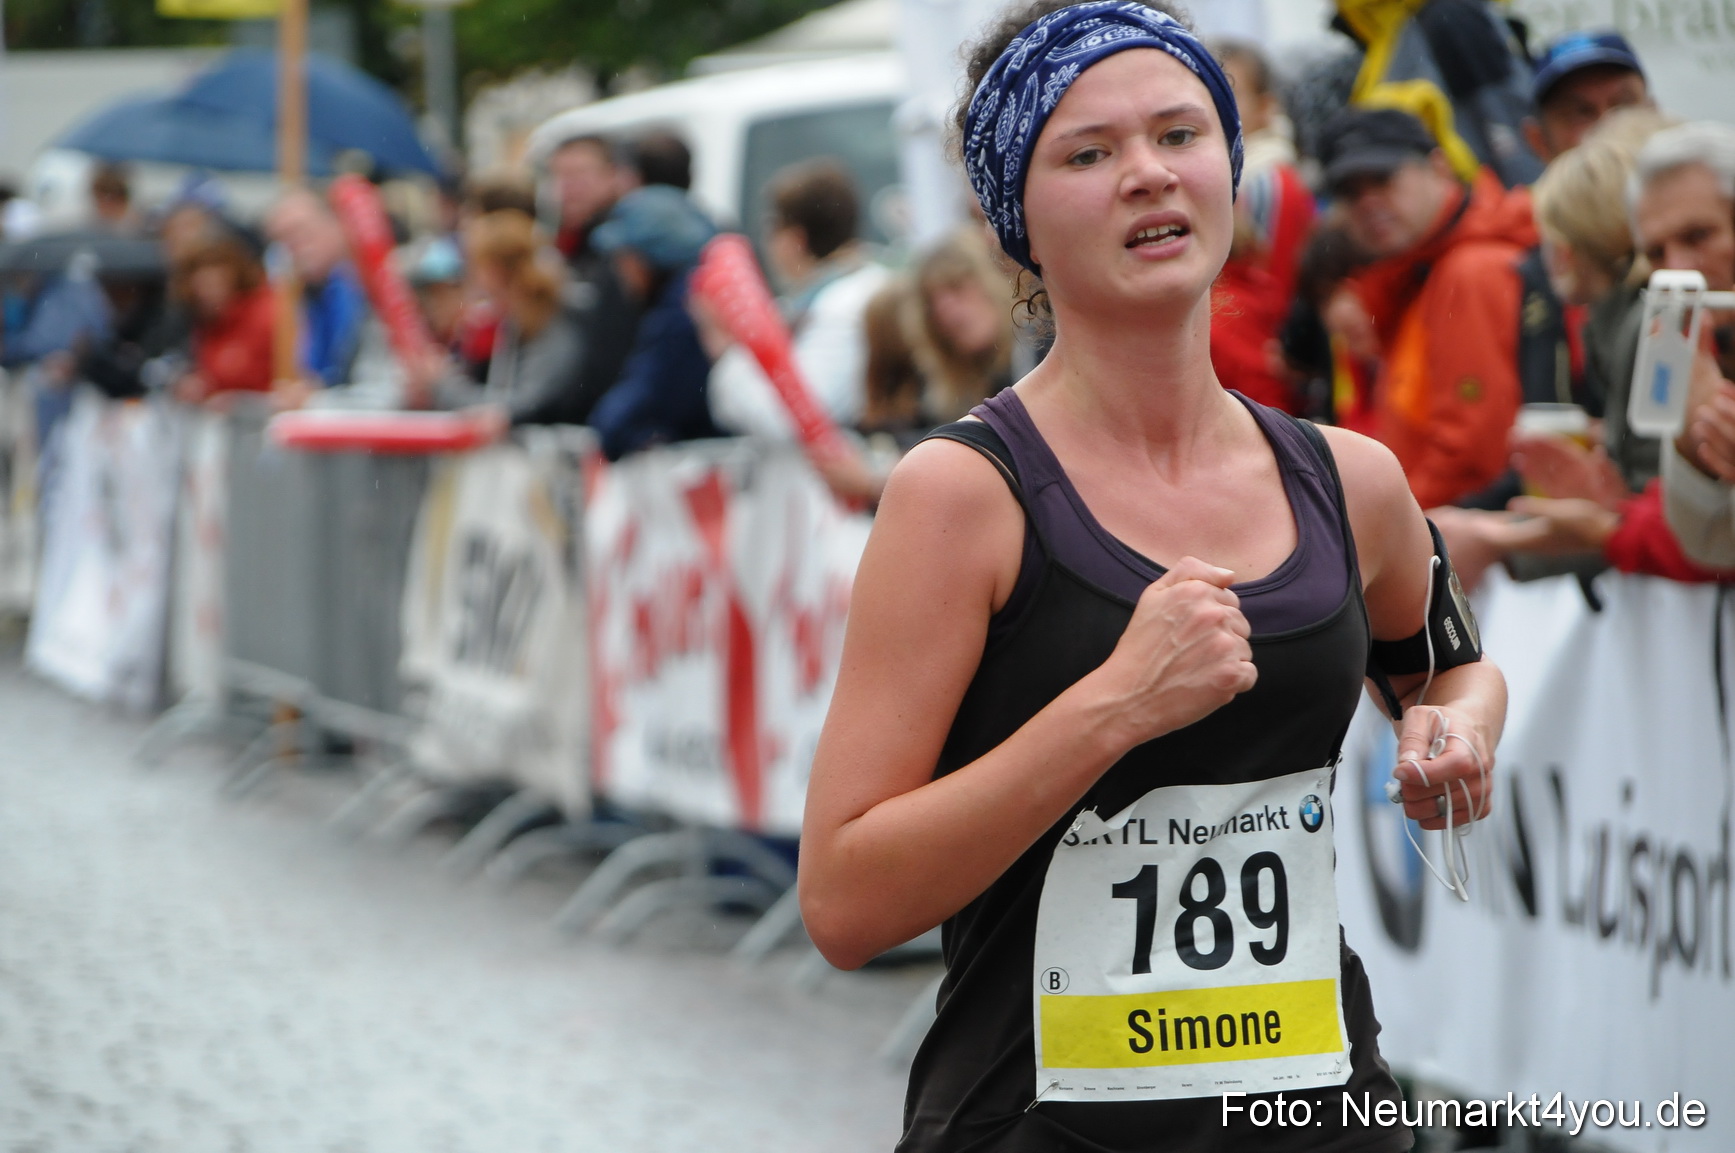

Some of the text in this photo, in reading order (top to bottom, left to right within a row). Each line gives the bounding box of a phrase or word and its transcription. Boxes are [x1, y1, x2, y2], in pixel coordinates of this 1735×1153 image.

[1168, 804, 1290, 845] Neumarkt
[1111, 850, 1290, 976] 189
[1049, 971, 1061, 991] B
[1127, 1008, 1282, 1054] Simone
